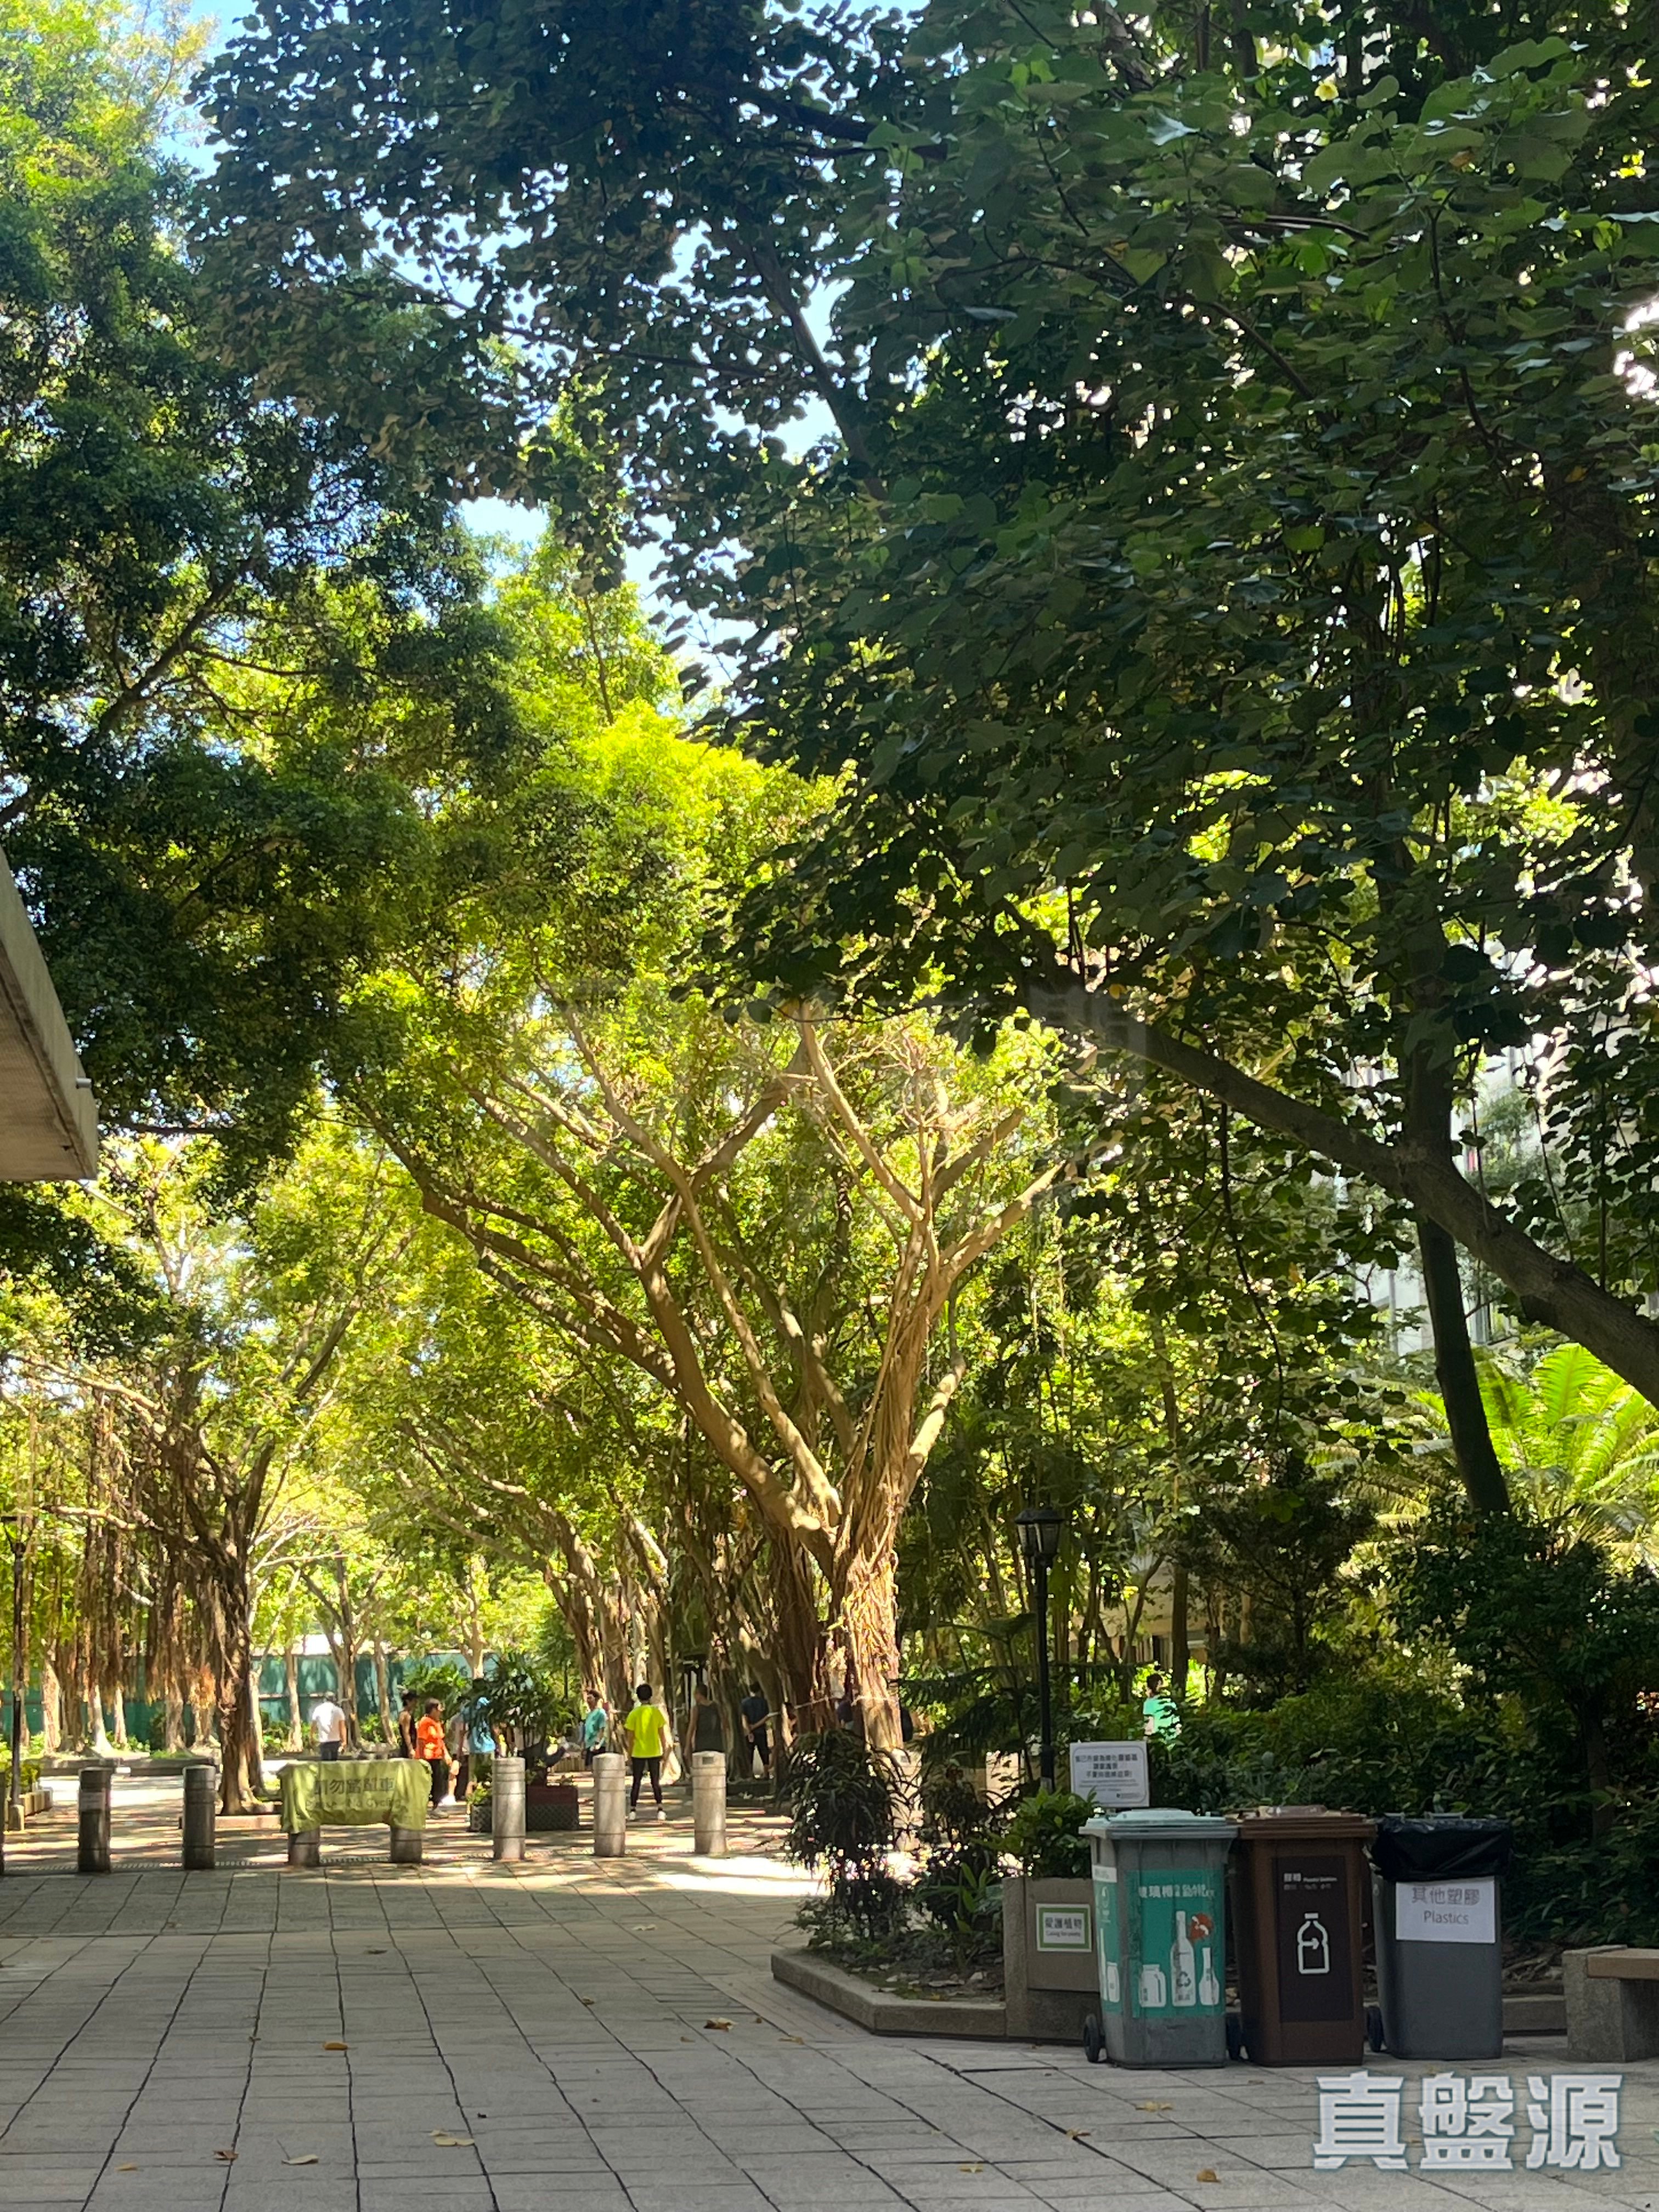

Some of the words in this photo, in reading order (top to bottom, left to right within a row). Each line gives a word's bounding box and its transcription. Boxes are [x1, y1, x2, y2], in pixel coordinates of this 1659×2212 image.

[1412, 1887, 1480, 1906] 其他塑膠
[1424, 1910, 1469, 1925] Plastics
